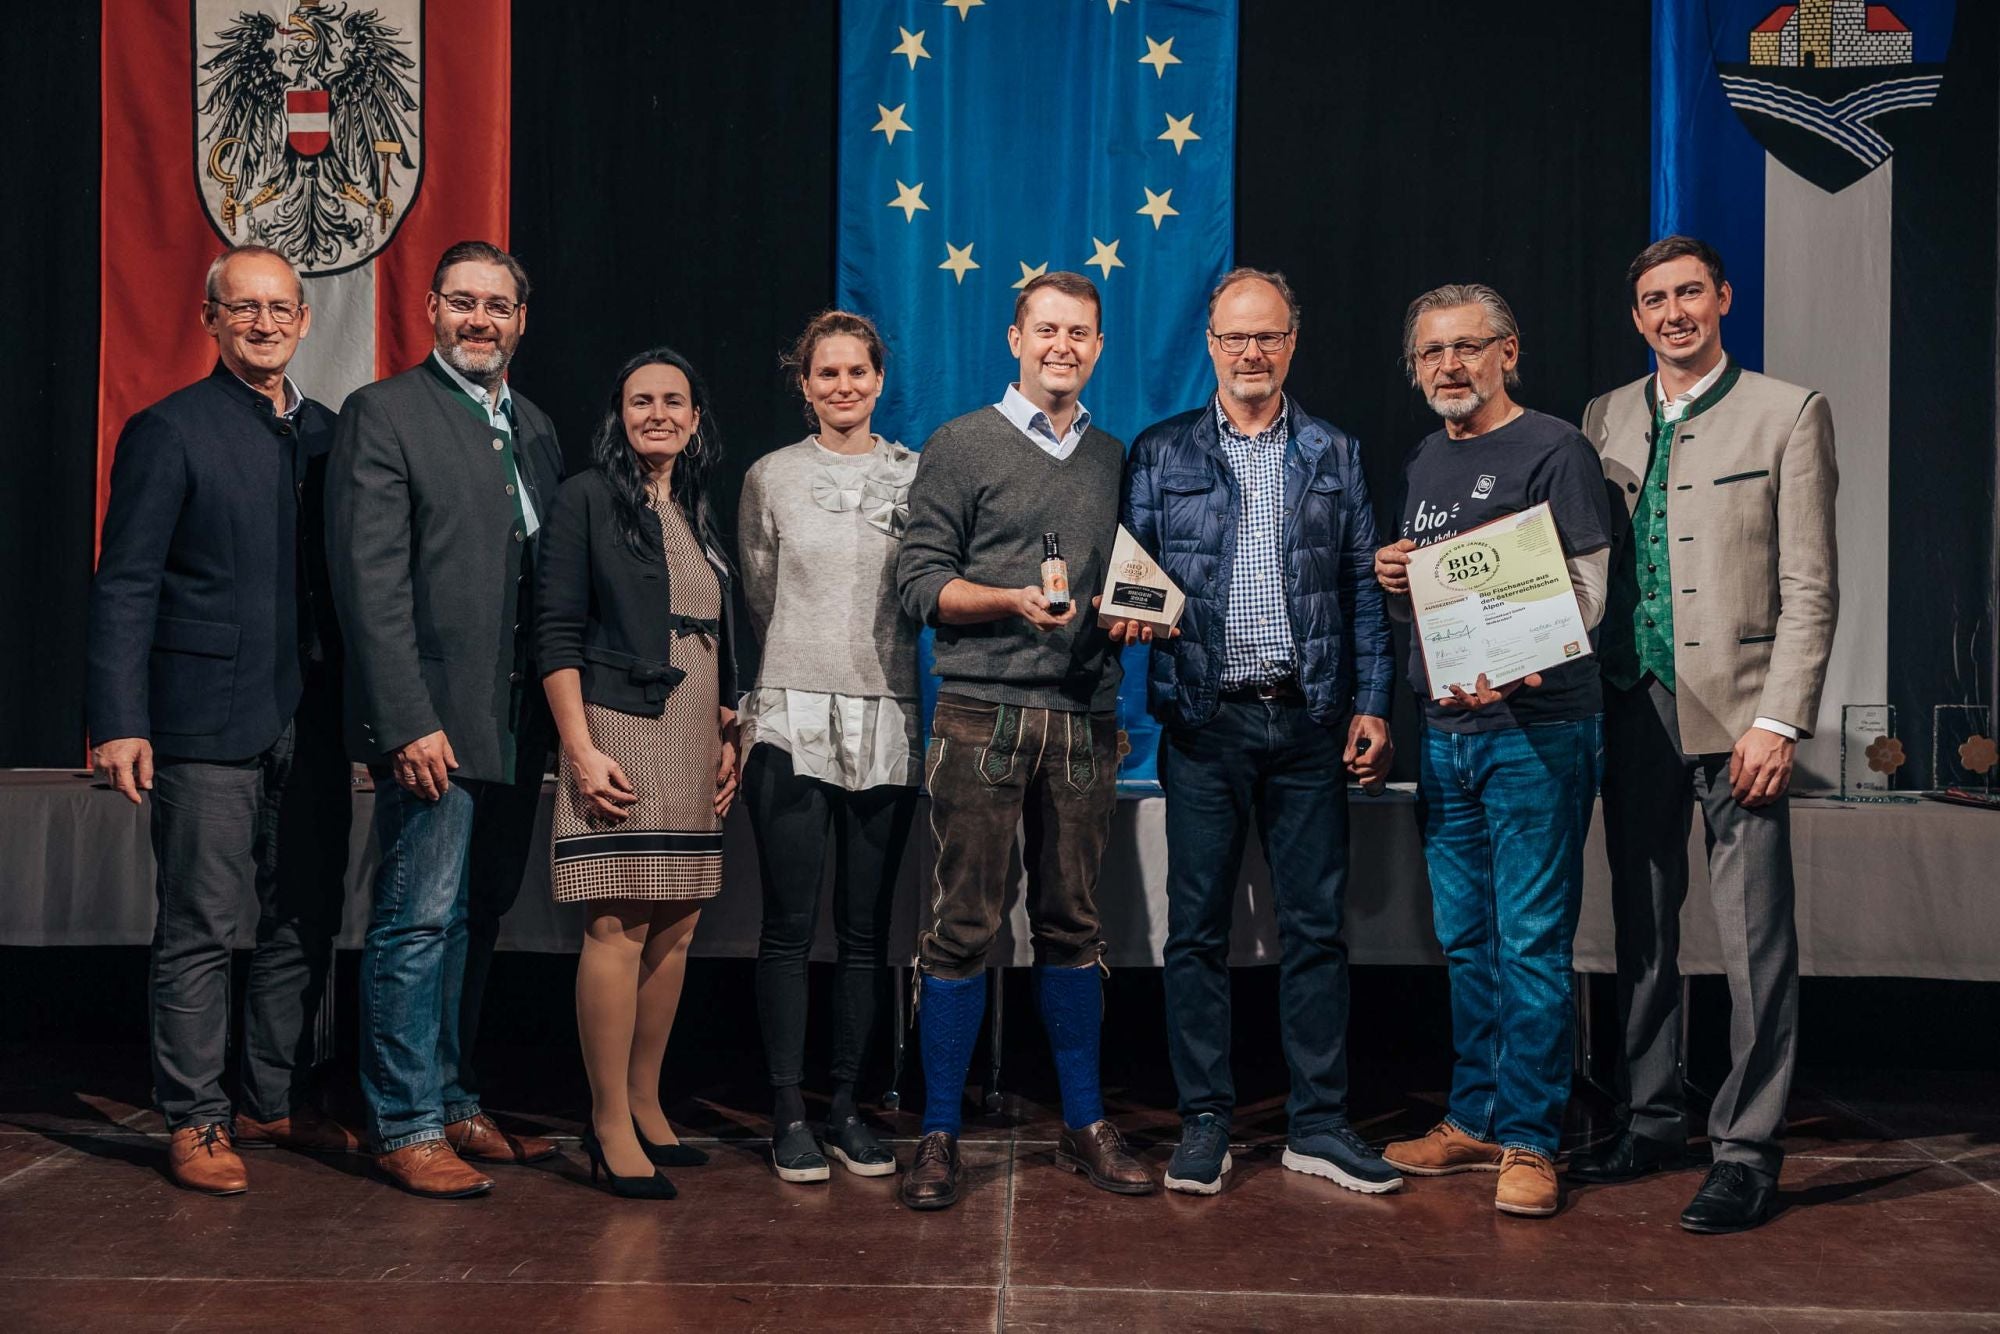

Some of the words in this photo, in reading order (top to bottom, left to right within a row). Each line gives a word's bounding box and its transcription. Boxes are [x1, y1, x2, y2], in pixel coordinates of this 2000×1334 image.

[1415, 500, 1448, 532] bio
[1448, 551, 1483, 571] BIO
[1446, 562, 1490, 583] 2024
[1480, 597, 1495, 605] den
[1496, 577, 1559, 600] österreichischen
[1493, 578, 1534, 595] Fischsauce
[1535, 573, 1549, 581] aus
[1482, 601, 1505, 611] Alpen
